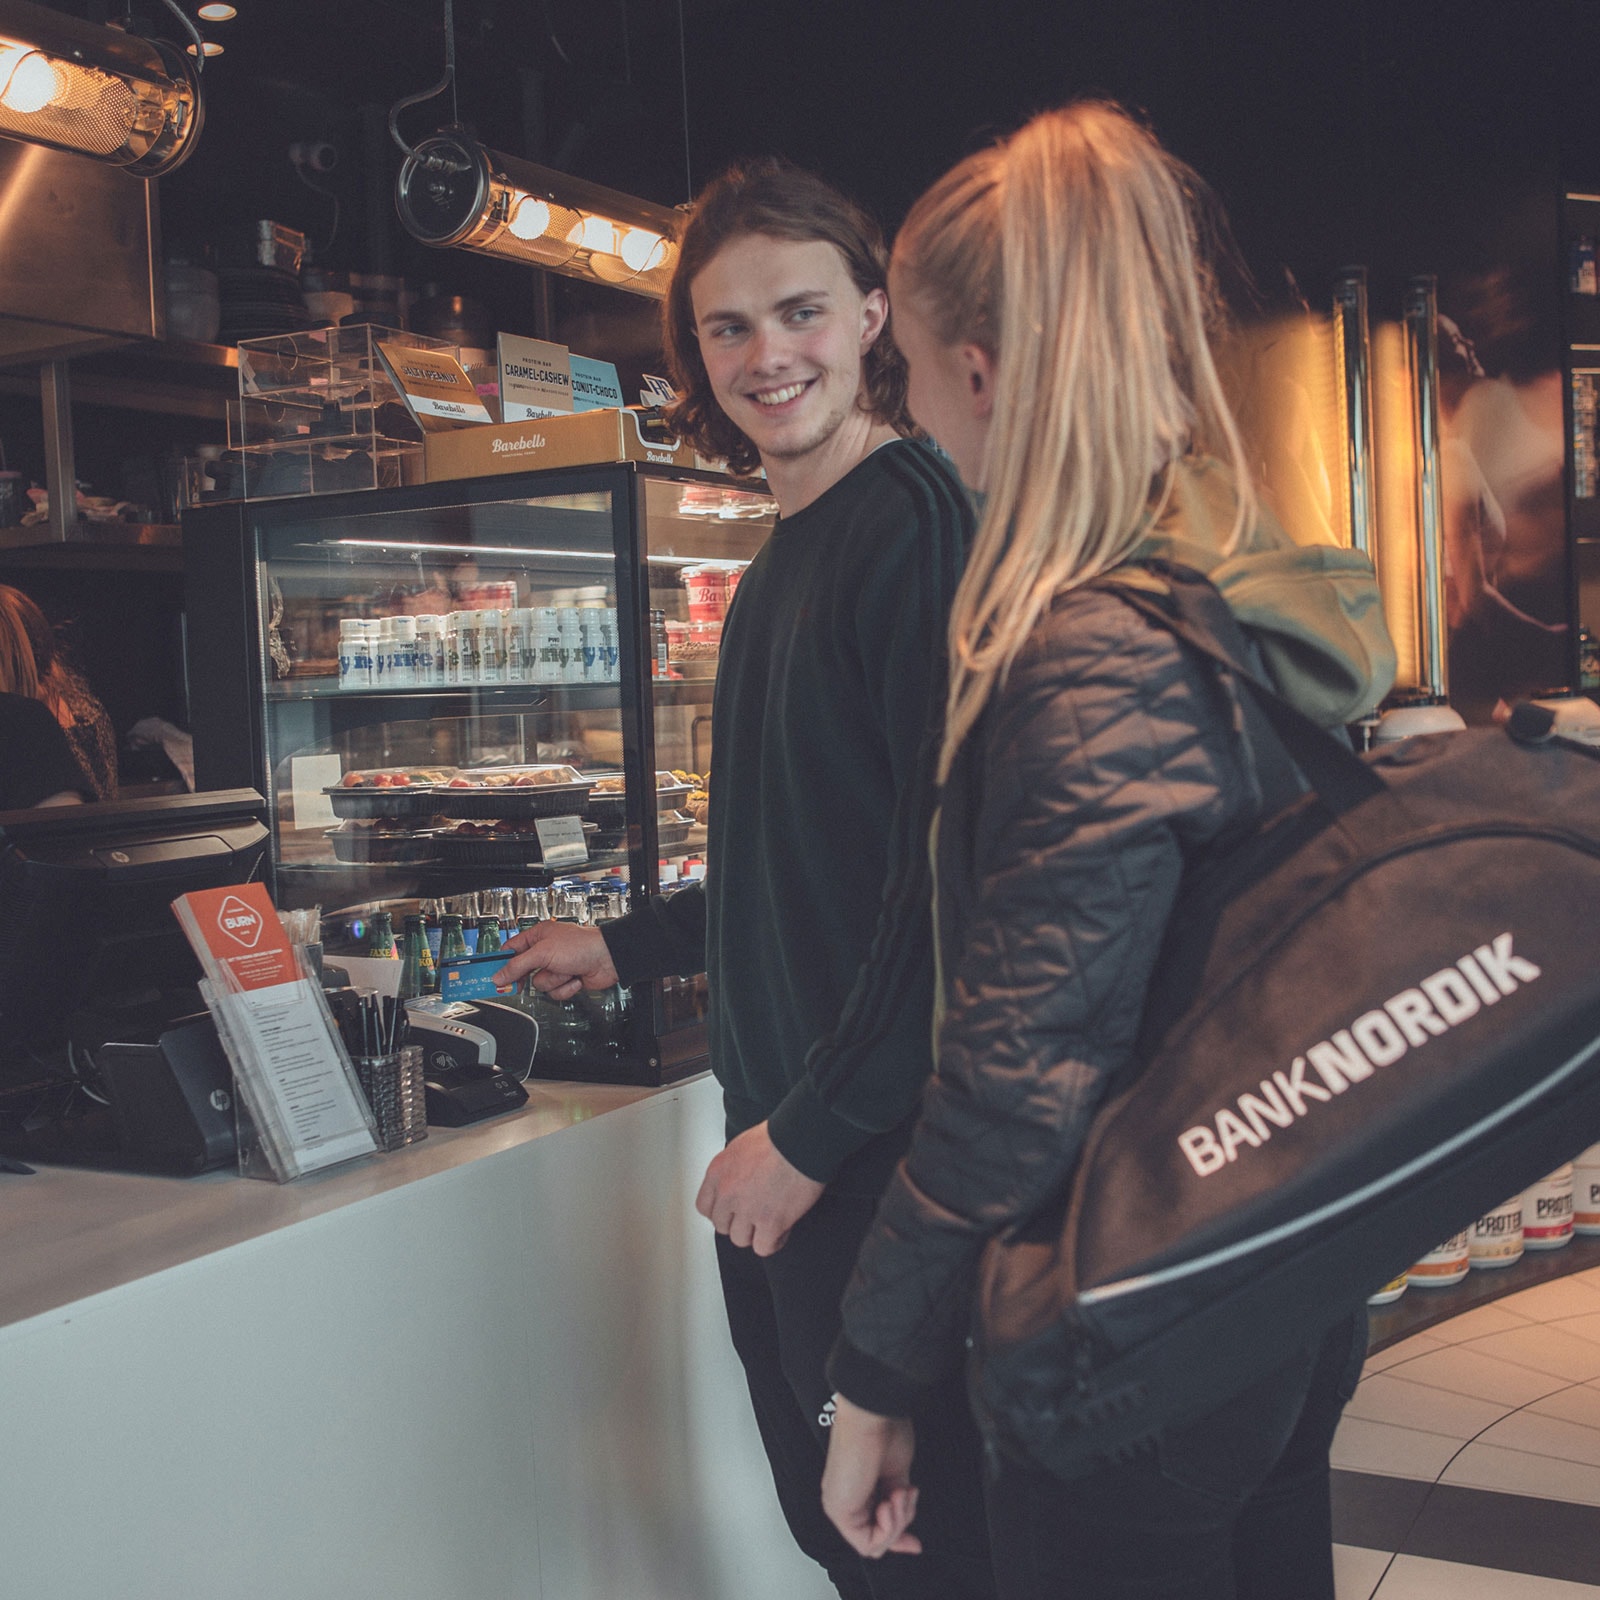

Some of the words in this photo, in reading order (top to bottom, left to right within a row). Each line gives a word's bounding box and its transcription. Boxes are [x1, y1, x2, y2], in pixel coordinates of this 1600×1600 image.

[522, 357, 541, 366] PROTEIN
[505, 364, 569, 386] CARAMEL-CASHEW
[432, 401, 466, 414] Barebells
[491, 434, 546, 453] Barebells
[646, 451, 674, 464] Barebells
[224, 914, 257, 929] BURN
[1177, 932, 1541, 1176] BANKNORDIK
